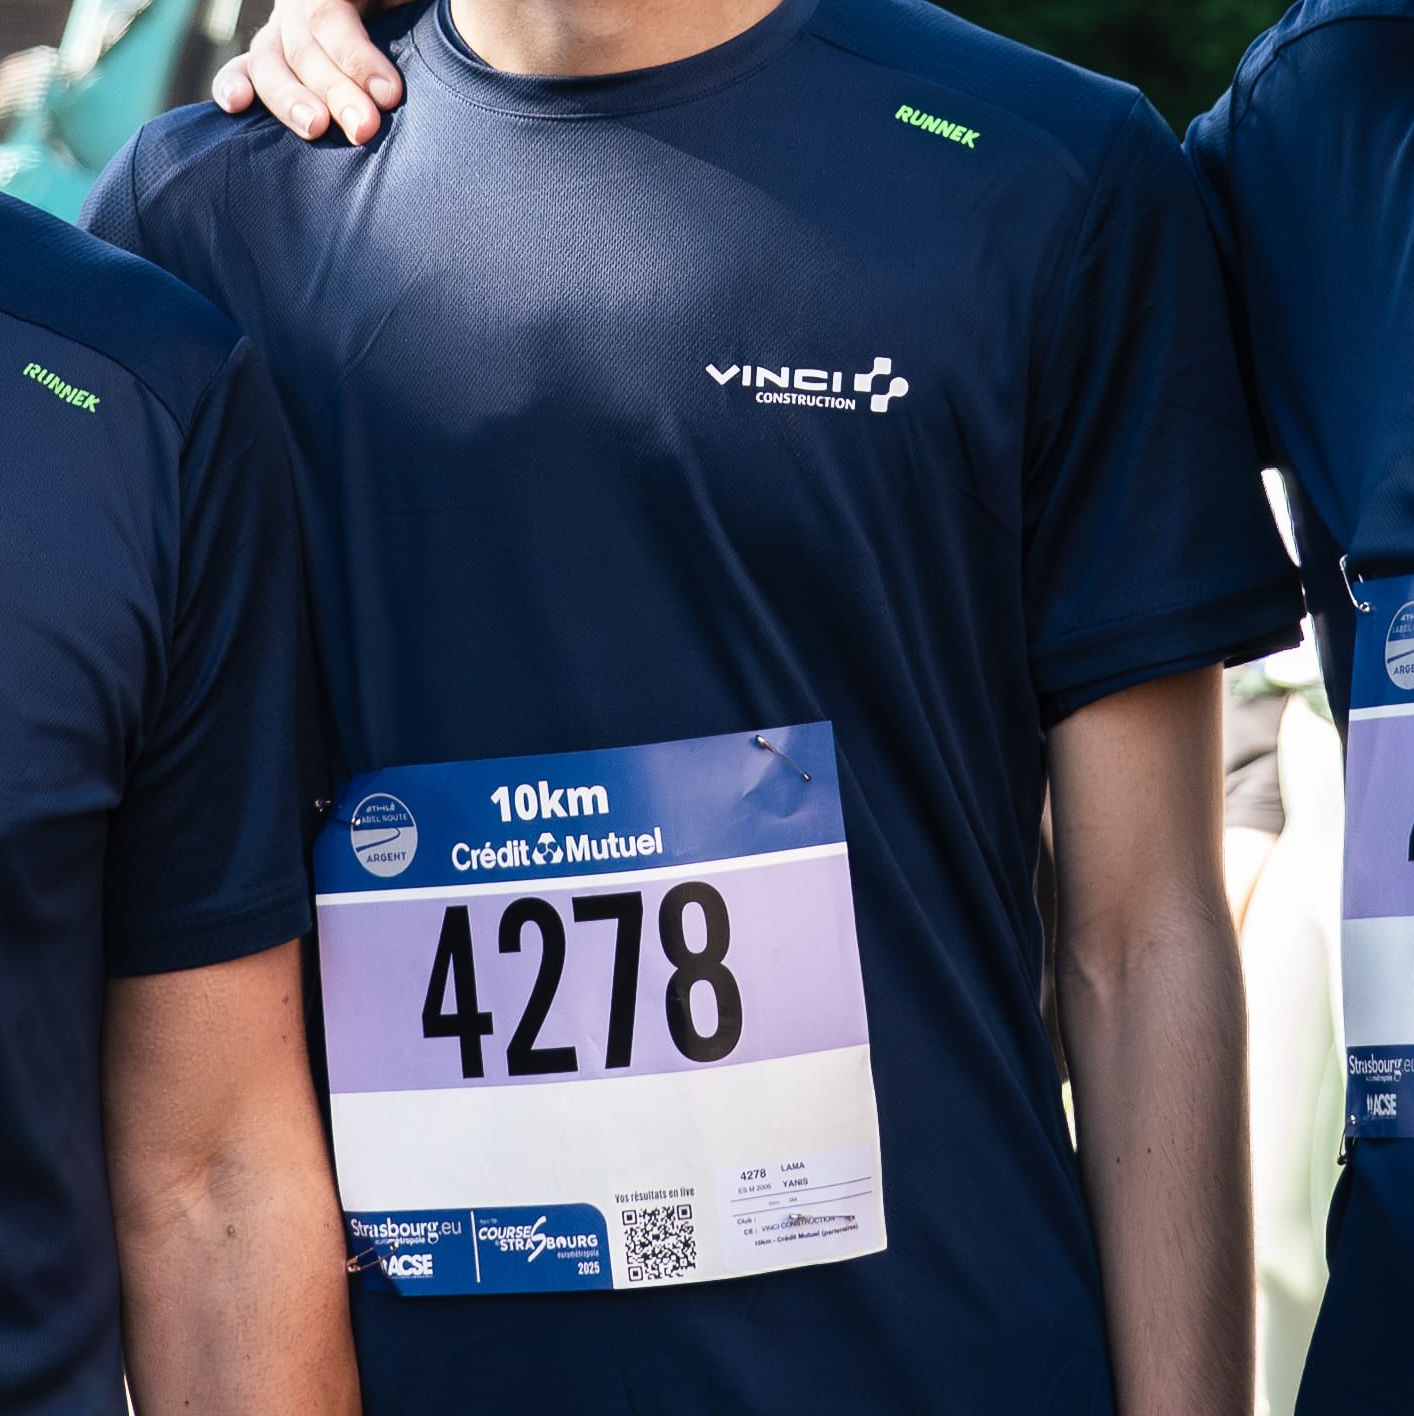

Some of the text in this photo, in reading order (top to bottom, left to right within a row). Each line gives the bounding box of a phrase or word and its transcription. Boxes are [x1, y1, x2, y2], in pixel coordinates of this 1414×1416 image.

[895, 104, 981, 149] RUNNEK
[23, 362, 101, 413] RUNNEK
[705, 363, 842, 393] VINCI
[755, 391, 856, 410] CONSTRUCTION
[490, 780, 609, 823] 10km
[367, 851, 407, 863] ARGENT
[452, 827, 663, 871] Crédit Mutuel
[422, 880, 743, 1079] 4278
[740, 1161, 805, 1181] 4278 LAMA
[782, 1177, 809, 1188] YANIS
[615, 1186, 695, 1203] Vos résultats en live
[351, 1216, 462, 1245] Strasbourg.eu
[761, 1222, 780, 1232] VINCI
[387, 1253, 433, 1277] ACSE
[578, 1262, 600, 1275] 2025
